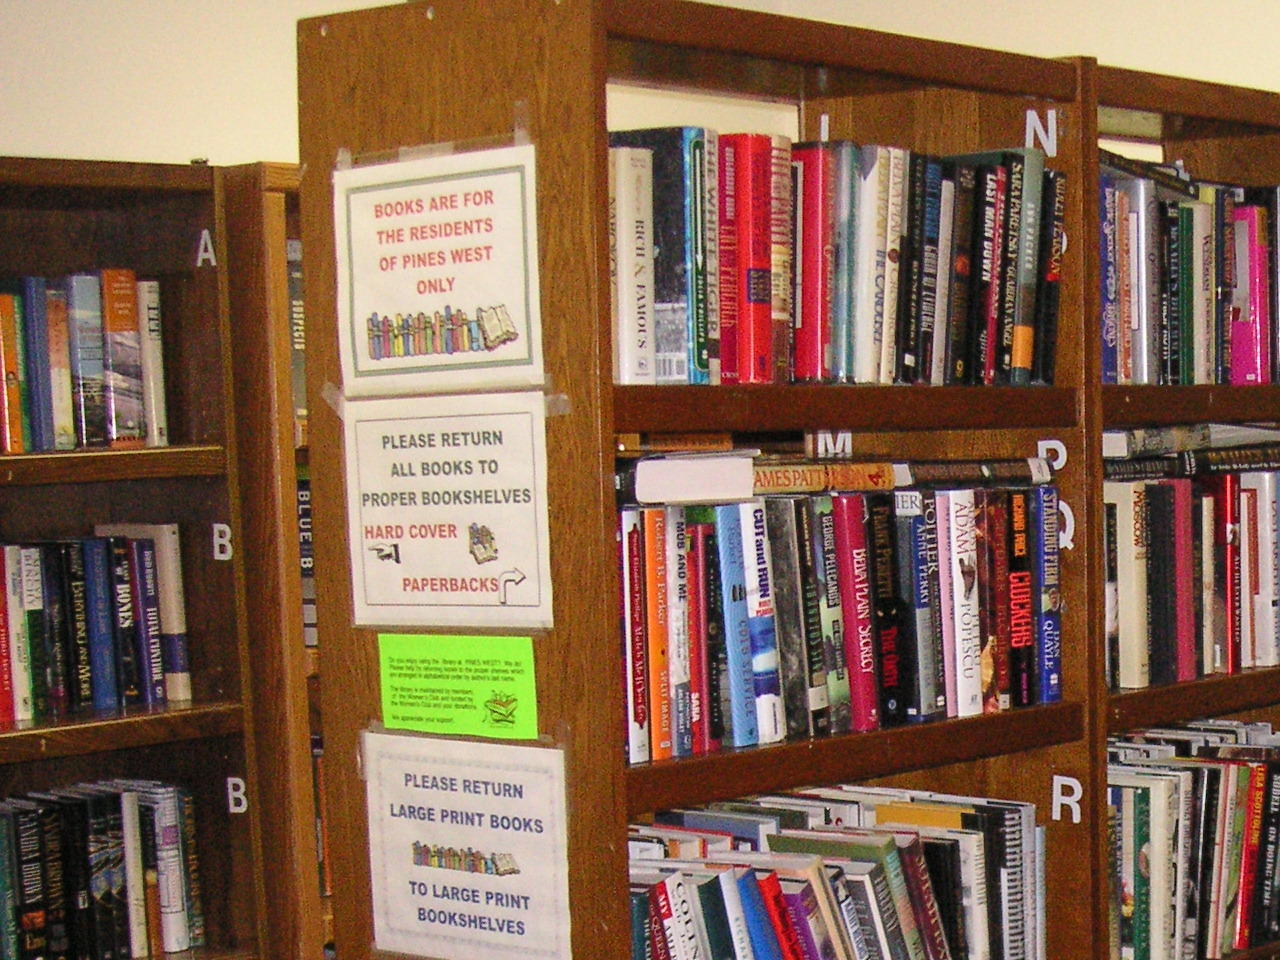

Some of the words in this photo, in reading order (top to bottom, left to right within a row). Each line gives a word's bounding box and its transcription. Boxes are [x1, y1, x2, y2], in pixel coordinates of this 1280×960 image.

[1025, 109, 1057, 158] N
[706, 139, 717, 175] THE
[984, 173, 997, 204] LAST
[1010, 162, 1023, 197] SARA
[374, 199, 424, 219] BOOKS
[429, 194, 459, 212] ARE
[463, 189, 494, 207] FOR
[377, 228, 405, 245] THE
[410, 218, 494, 241] RESIDENTS
[635, 219, 647, 258] RICH
[706, 198, 717, 260] WHITE
[983, 206, 996, 238] MAN
[1007, 198, 1021, 260] PARETSKY
[196, 228, 217, 267] A
[379, 256, 397, 272] OF
[403, 251, 446, 270] PINES
[450, 246, 494, 265] WEST
[981, 240, 993, 282] DOWN
[417, 277, 456, 295] ONLY
[708, 269, 719, 332] TIGER
[635, 284, 648, 349] FAMOUS
[1002, 315, 1014, 347] ANGEL
[382, 433, 436, 449] PLEASE
[441, 431, 503, 447] RETURN
[817, 430, 852, 458] M
[391, 462, 416, 477] ALL
[422, 460, 473, 476] BOOKS
[478, 459, 499, 474] TO
[362, 492, 417, 507] PROPER
[422, 488, 531, 506] BOOKSHELVES
[298, 490, 312, 542] BLUE
[364, 524, 403, 539] HARD
[409, 524, 457, 538] COVER
[752, 508, 765, 538] CUT
[822, 515, 836, 551] GEORGE
[955, 502, 970, 556] ADAM
[1042, 493, 1058, 552] STANDING
[1132, 489, 1145, 548] MOSCOW
[213, 523, 233, 561] B
[654, 516, 665, 562] Robert
[676, 521, 686, 550] MOB
[755, 538, 767, 566] and
[916, 523, 928, 558] ANNE
[924, 498, 939, 575] POITIER
[656, 565, 665, 578] B.
[677, 553, 687, 580] AND
[852, 548, 869, 582] BELVA
[1044, 553, 1060, 586] FIRM
[402, 577, 499, 592] PAPERBACKS
[678, 583, 687, 603] ME
[757, 567, 771, 599] RUN
[918, 564, 930, 604] PERRY
[657, 582, 666, 626] Parker
[854, 582, 870, 620] PLAIN
[1009, 571, 1033, 648] CLOCKERS
[737, 619, 749, 658] COLD
[856, 624, 875, 674] SECRECY
[960, 603, 974, 680] POPESCU
[1043, 619, 1055, 670] QUAYLE
[659, 670, 668, 696] SPLIT
[742, 661, 752, 718] SERVICE
[660, 698, 669, 733] IMAGE
[404, 772, 458, 791] PLEASE
[463, 779, 523, 798] RETURN
[1254, 766, 1266, 789] LISA
[227, 777, 248, 814] B
[1052, 775, 1083, 824] R
[390, 803, 435, 822] LARGE
[441, 809, 484, 827] PRINT
[490, 814, 544, 834] BOOKS
[23, 863, 43, 904] BROWN
[408, 880, 427, 896] TO
[432, 884, 480, 903] LARGE
[485, 891, 530, 910] PRINT
[1262, 879, 1273, 906] TIME
[418, 907, 525, 935] BOOKSHELVES
[657, 893, 670, 915] MY
[675, 881, 700, 960] COLIN
[651, 916, 668, 960] QUEEN
